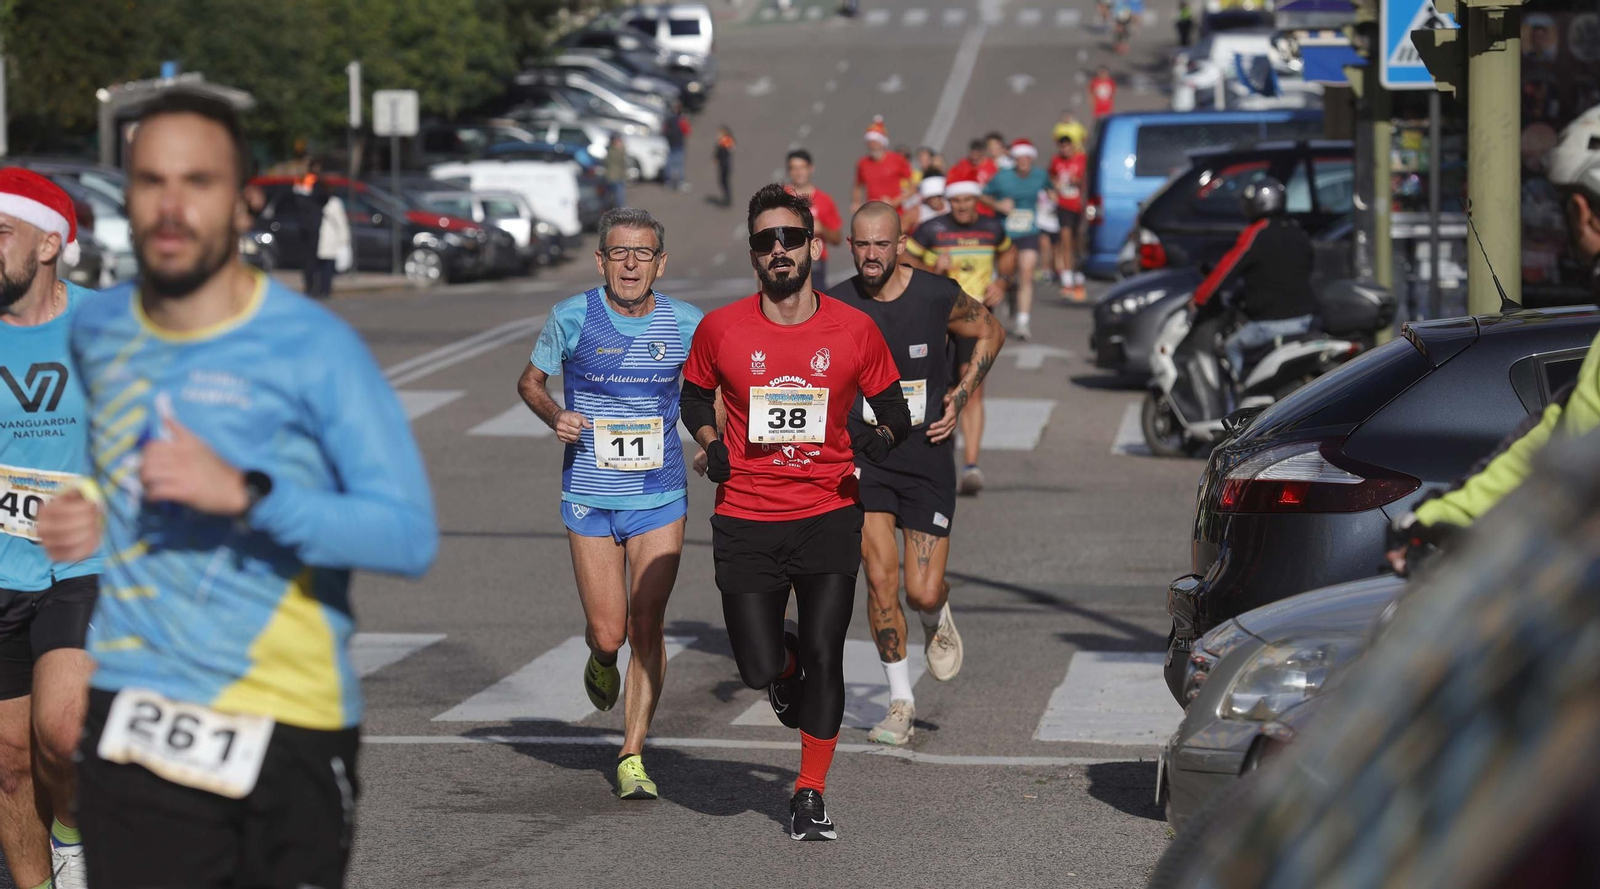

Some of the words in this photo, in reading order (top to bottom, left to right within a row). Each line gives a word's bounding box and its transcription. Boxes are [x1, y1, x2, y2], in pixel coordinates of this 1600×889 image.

[584, 372, 604, 383] Club
[605, 373, 649, 384] Atletismo
[769, 375, 806, 387] SOLIDARIA
[0, 417, 77, 429] VANGUARDIA
[768, 407, 807, 429] 38
[13, 428, 65, 439] NATURAL
[611, 437, 644, 457] 11
[127, 699, 239, 763] 261
